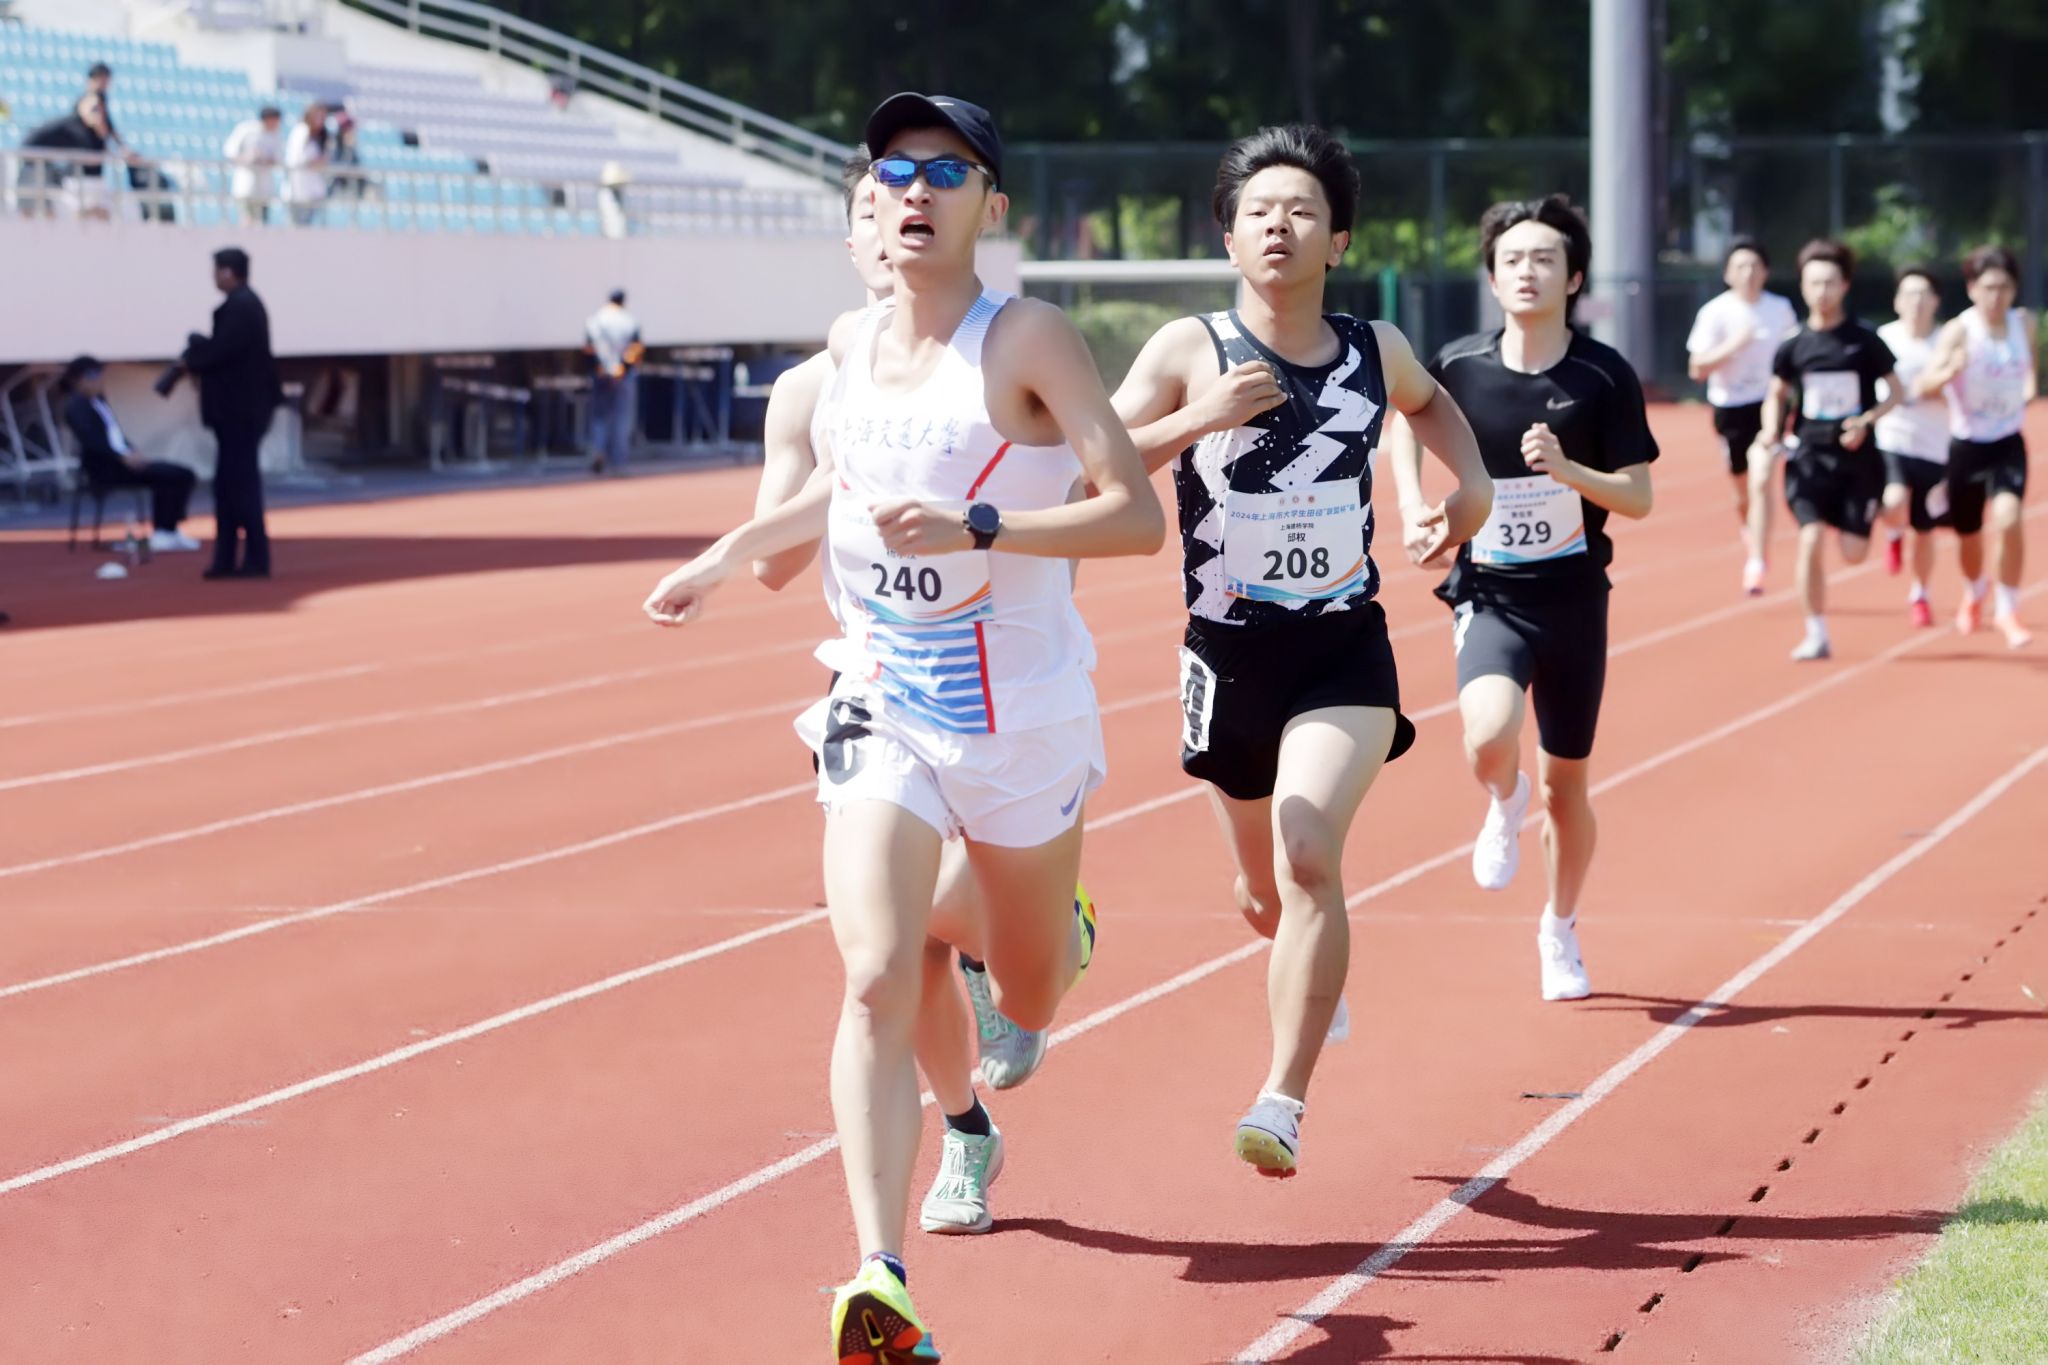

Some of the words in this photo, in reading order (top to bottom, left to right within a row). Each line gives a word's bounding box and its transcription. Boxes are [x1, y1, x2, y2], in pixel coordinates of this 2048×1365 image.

[1499, 520, 1552, 547] 329
[1263, 547, 1330, 581] 208
[871, 562, 942, 602] 240
